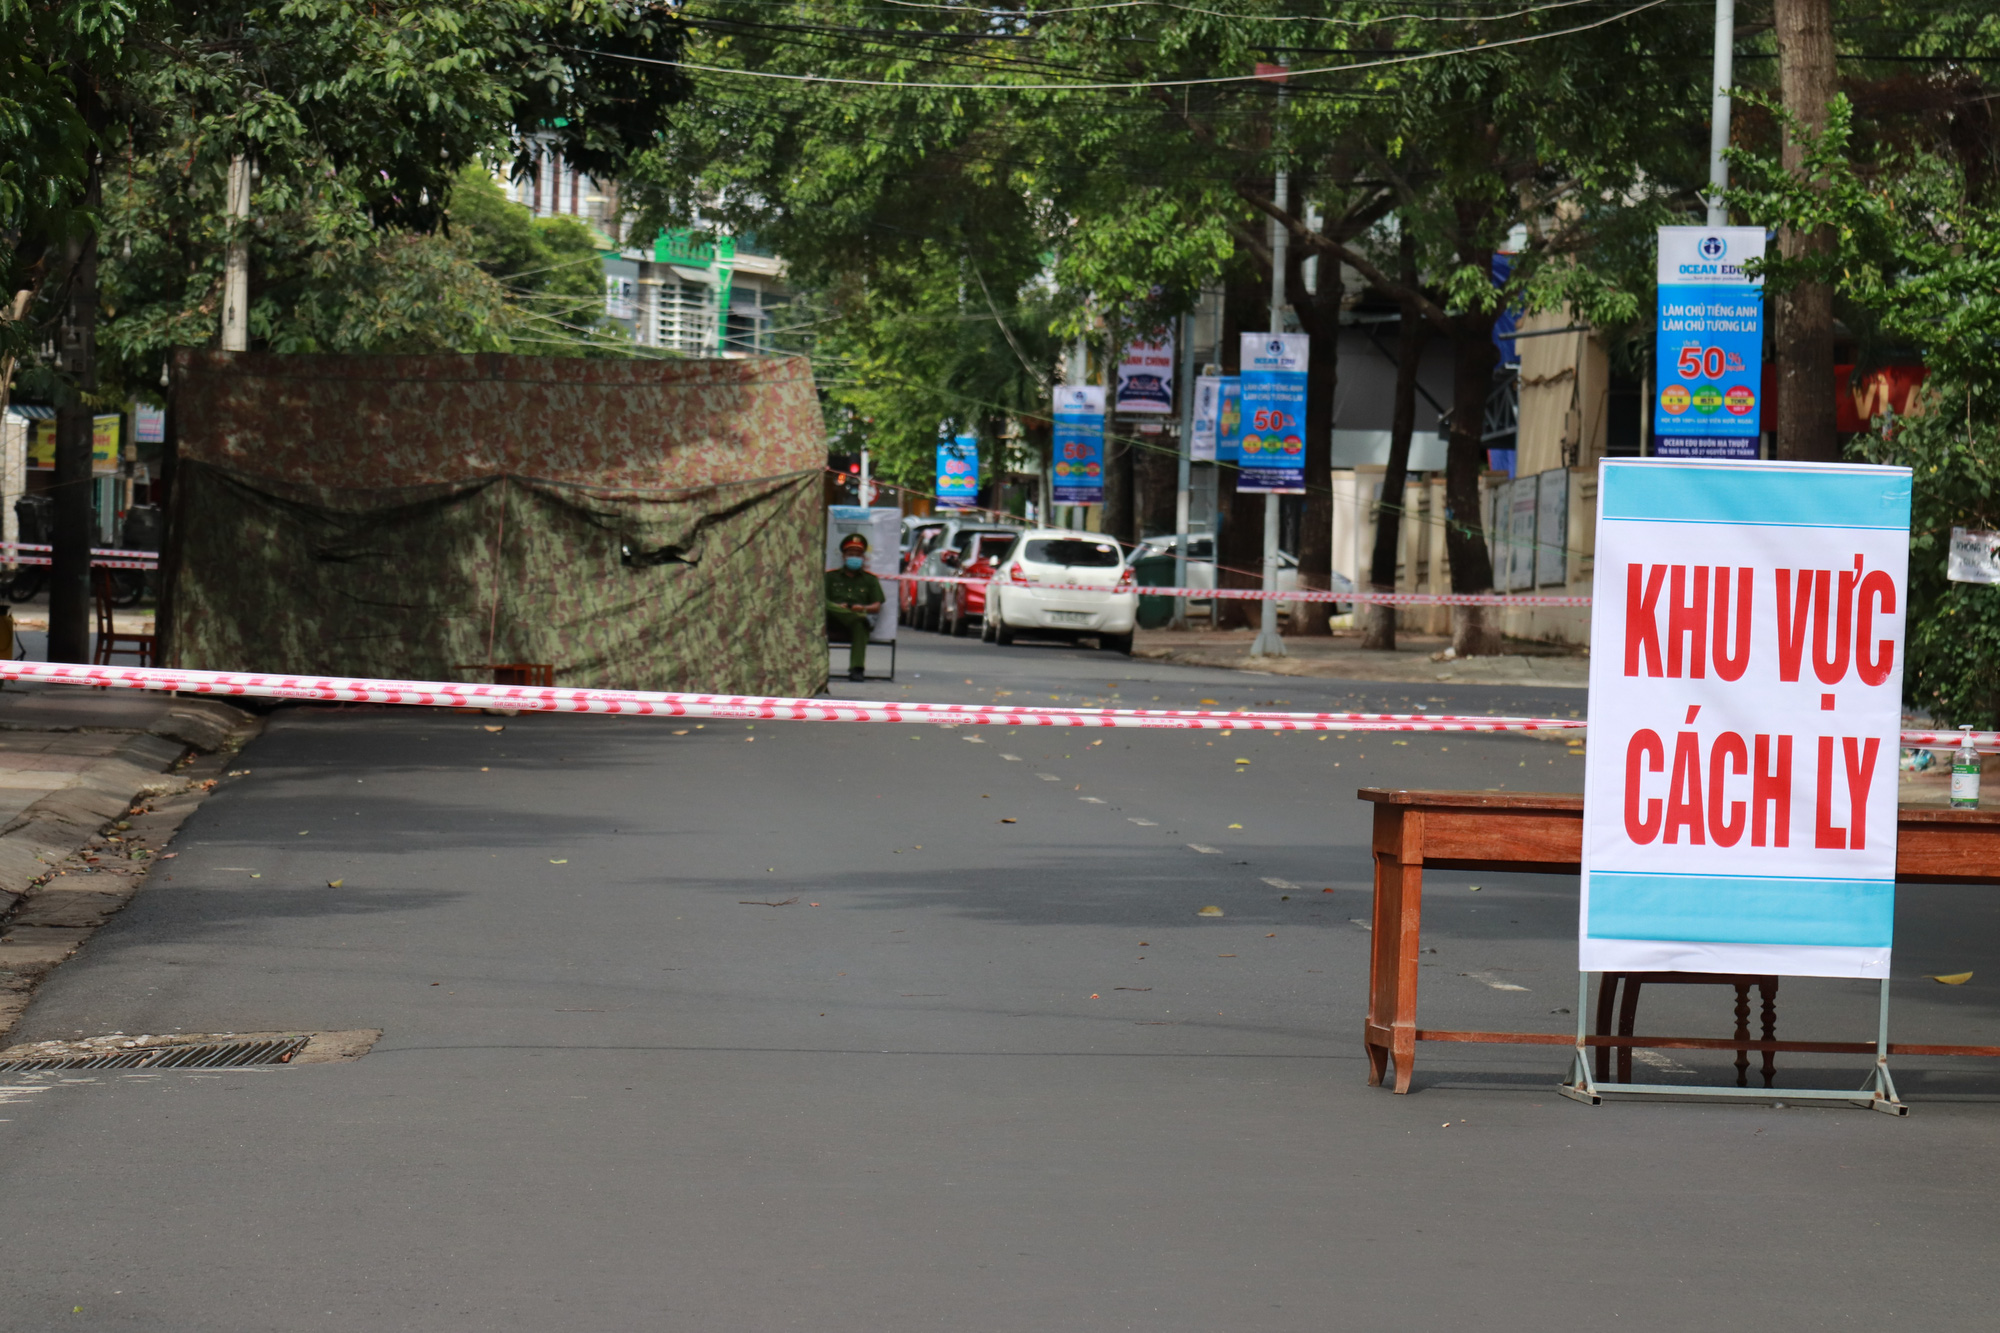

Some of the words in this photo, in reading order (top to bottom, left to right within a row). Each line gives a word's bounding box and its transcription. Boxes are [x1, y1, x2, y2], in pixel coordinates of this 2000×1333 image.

[1679, 264, 1718, 275] OCEAN
[1662, 303, 1684, 317] LÀM
[1685, 302, 1706, 317] CHỦ
[1707, 303, 1735, 317] TIẾNG
[1735, 306, 1758, 317] ANH
[1662, 318, 1684, 332] LÀM
[1684, 317, 1705, 332] CHỦ
[1706, 320, 1740, 332] TƯƠNG
[1741, 321, 1757, 332] LAI
[1663, 438, 1684, 448] OCEAN
[1685, 439, 1698, 448] EDU
[1699, 437, 1716, 448] BUÔN
[1717, 439, 1728, 448] MA
[1624, 563, 1754, 682] KHU
[1775, 553, 1896, 711] VỰC
[1624, 705, 1793, 848] CÁCH
[1815, 736, 1880, 850] LY
